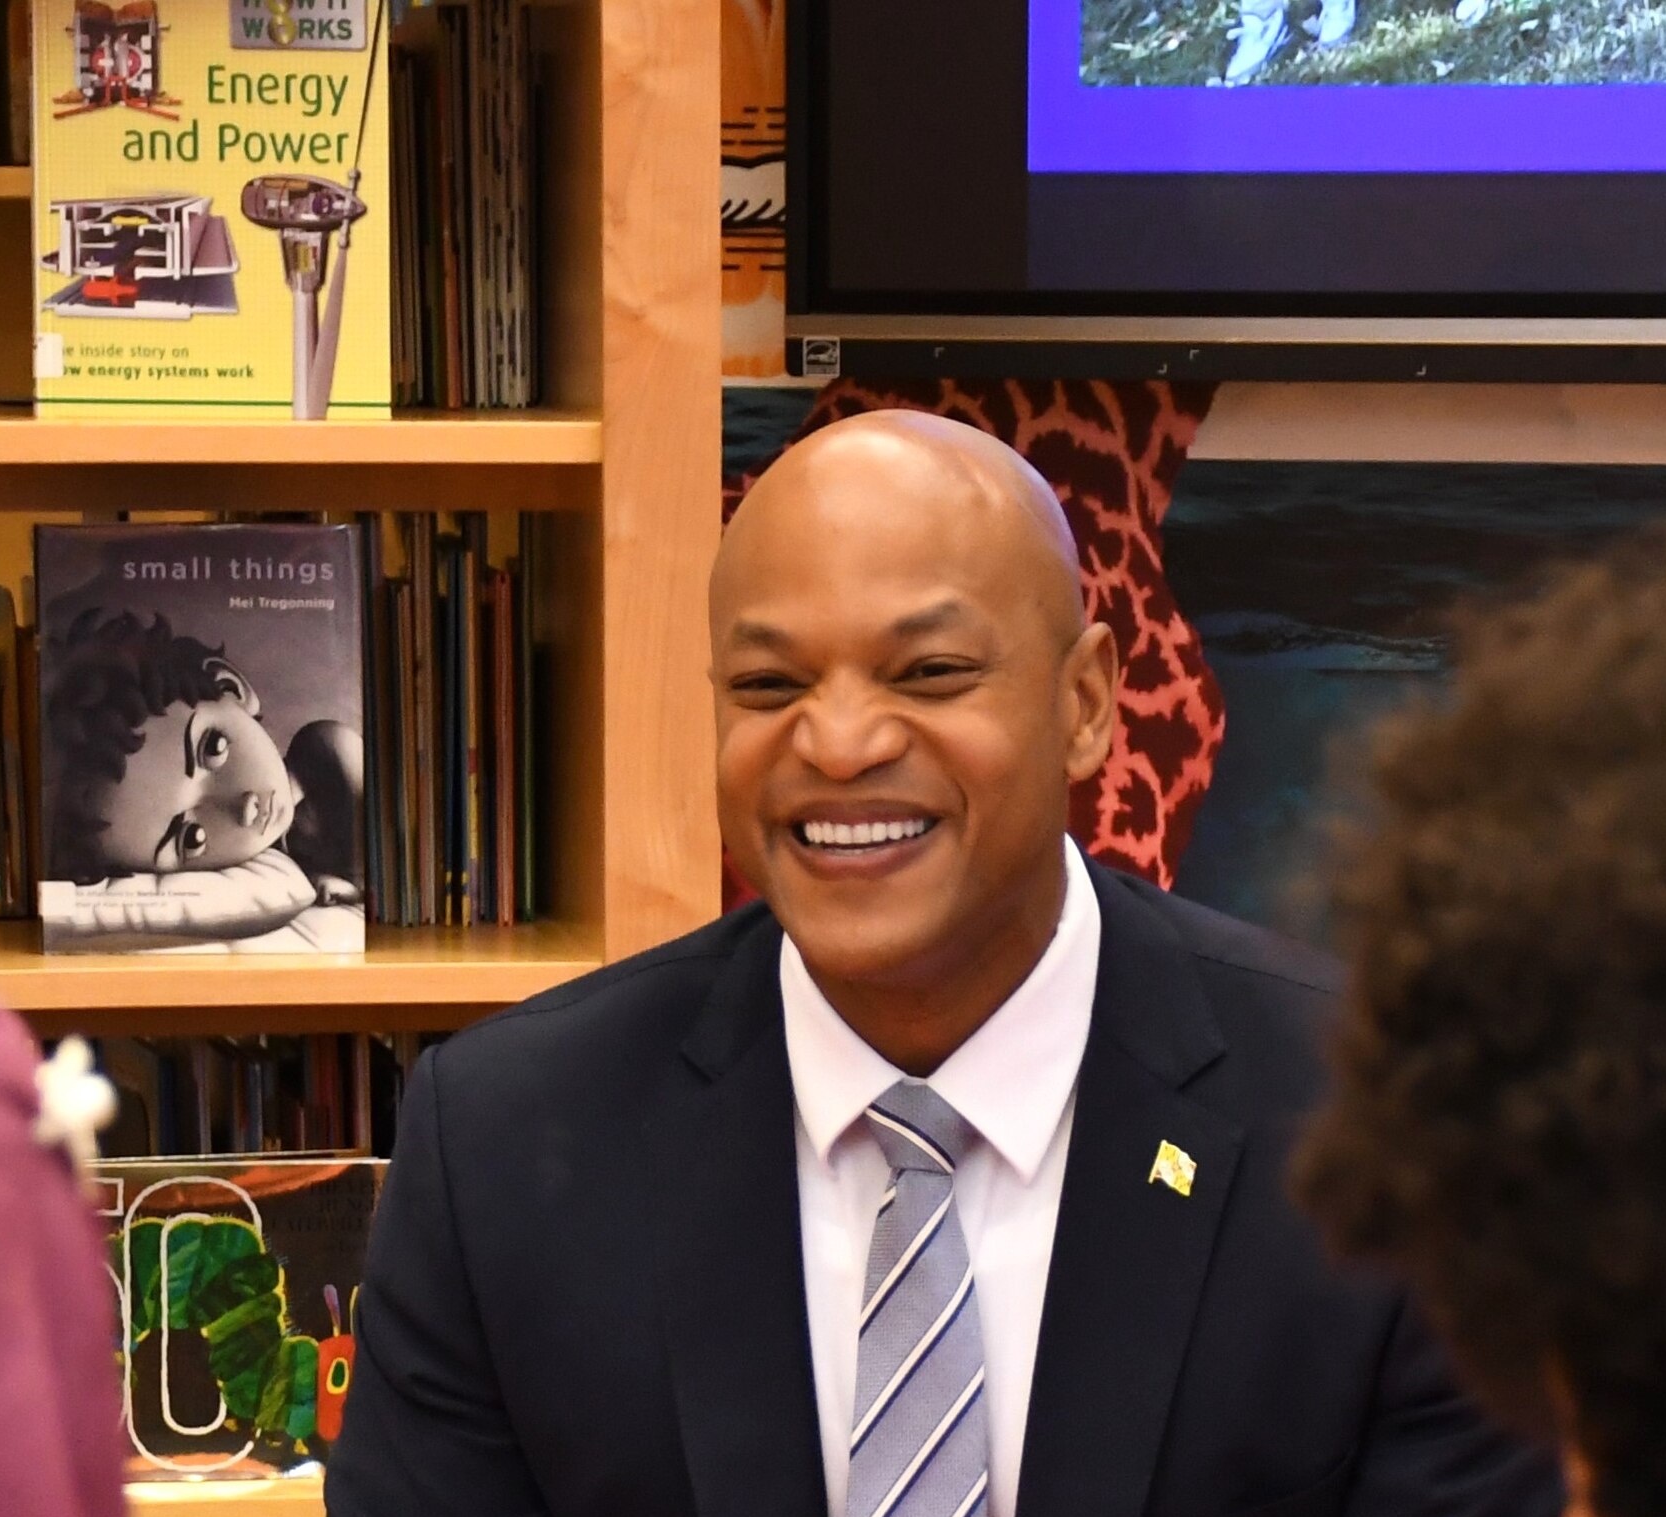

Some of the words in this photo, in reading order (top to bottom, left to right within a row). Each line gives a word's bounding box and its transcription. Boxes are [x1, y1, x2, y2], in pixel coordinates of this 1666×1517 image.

[242, 17, 353, 45] WORKS
[208, 65, 348, 117] Energy
[123, 119, 199, 163] and
[219, 123, 350, 164] Power
[79, 343, 124, 358] inside
[130, 344, 166, 360] story
[171, 346, 190, 358] on
[87, 365, 141, 381] energy
[147, 365, 210, 381] systems
[216, 364, 254, 378] work
[123, 556, 211, 580] small
[228, 557, 334, 585] things
[259, 597, 335, 611] Tregonning
